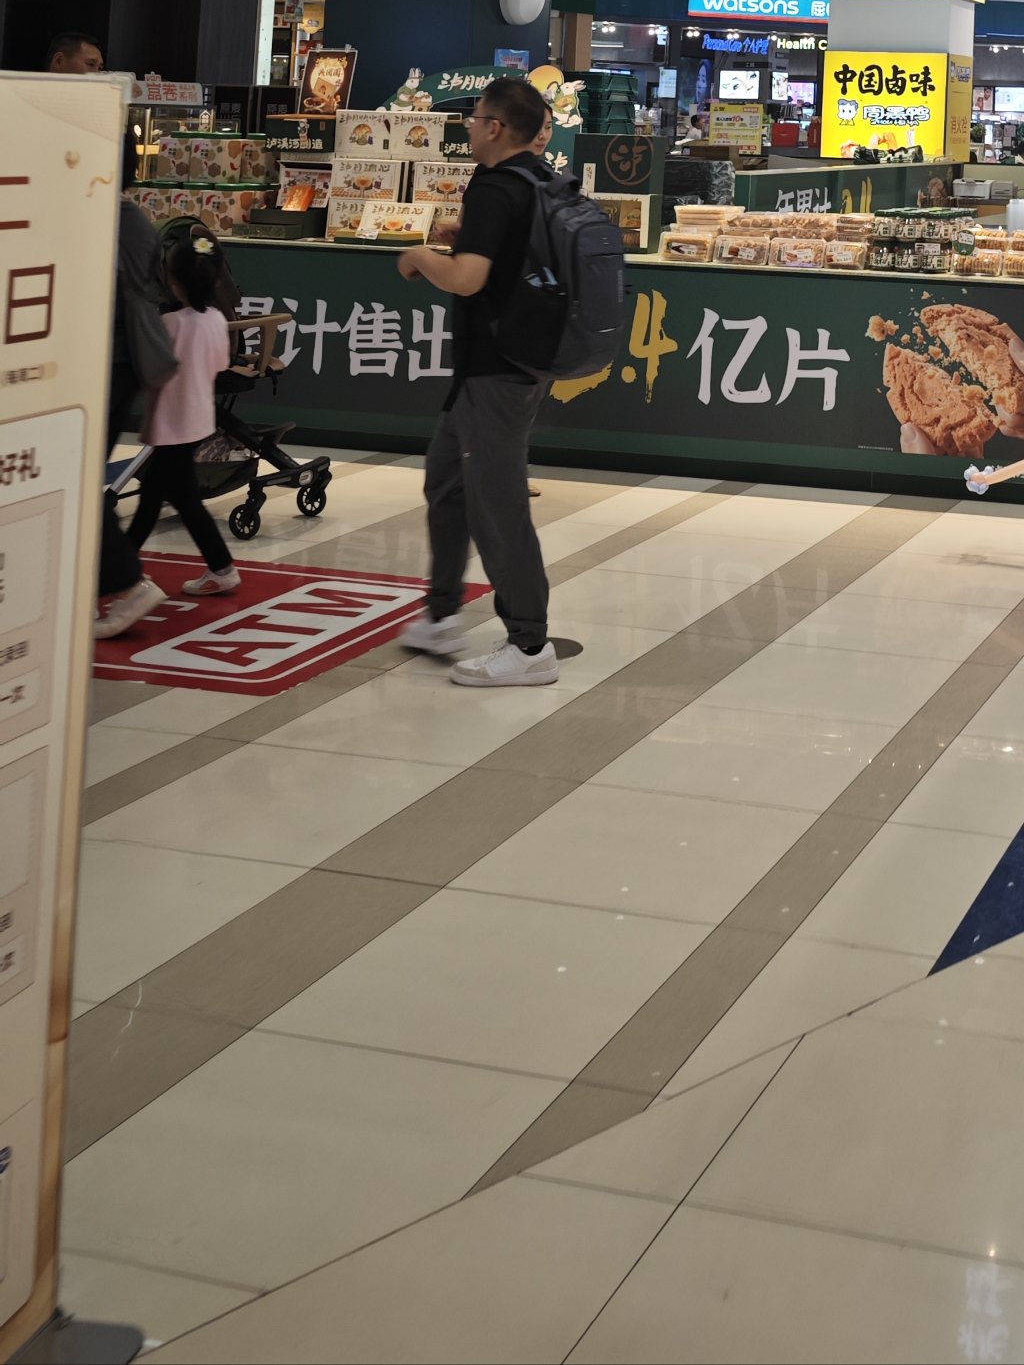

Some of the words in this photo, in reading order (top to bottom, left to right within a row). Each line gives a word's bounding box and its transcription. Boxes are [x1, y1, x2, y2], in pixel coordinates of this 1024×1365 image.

[810, 1, 830, 17] 屈
[777, 37, 815, 51] Health
[834, 64, 936, 97] 中国卤味
[862, 105, 931, 122] 周黑鸭
[171, 587, 401, 668] ATM
